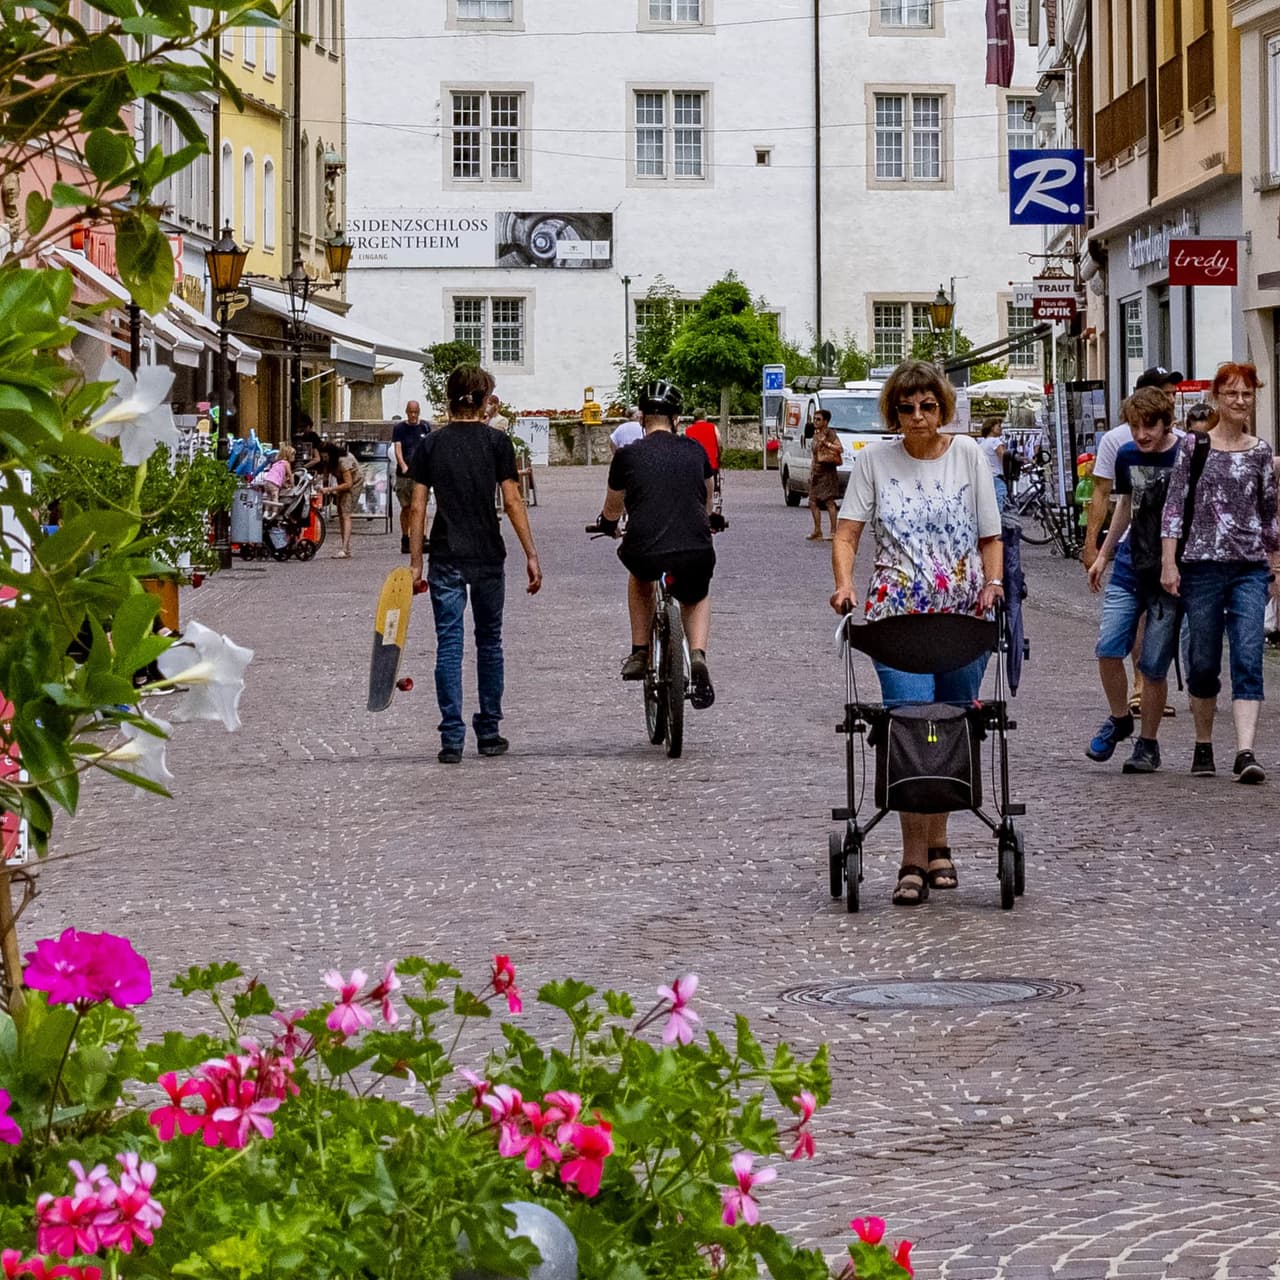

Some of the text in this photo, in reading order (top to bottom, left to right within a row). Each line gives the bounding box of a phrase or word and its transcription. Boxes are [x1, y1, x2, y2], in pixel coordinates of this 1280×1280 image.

[345, 218, 489, 232] ESIDENZSCHLOSS
[347, 236, 460, 249] ERGENTHEIM
[1174, 249, 1235, 277] tredy
[1037, 284, 1071, 293] TRAUT
[1037, 307, 1072, 317] OPTIK
